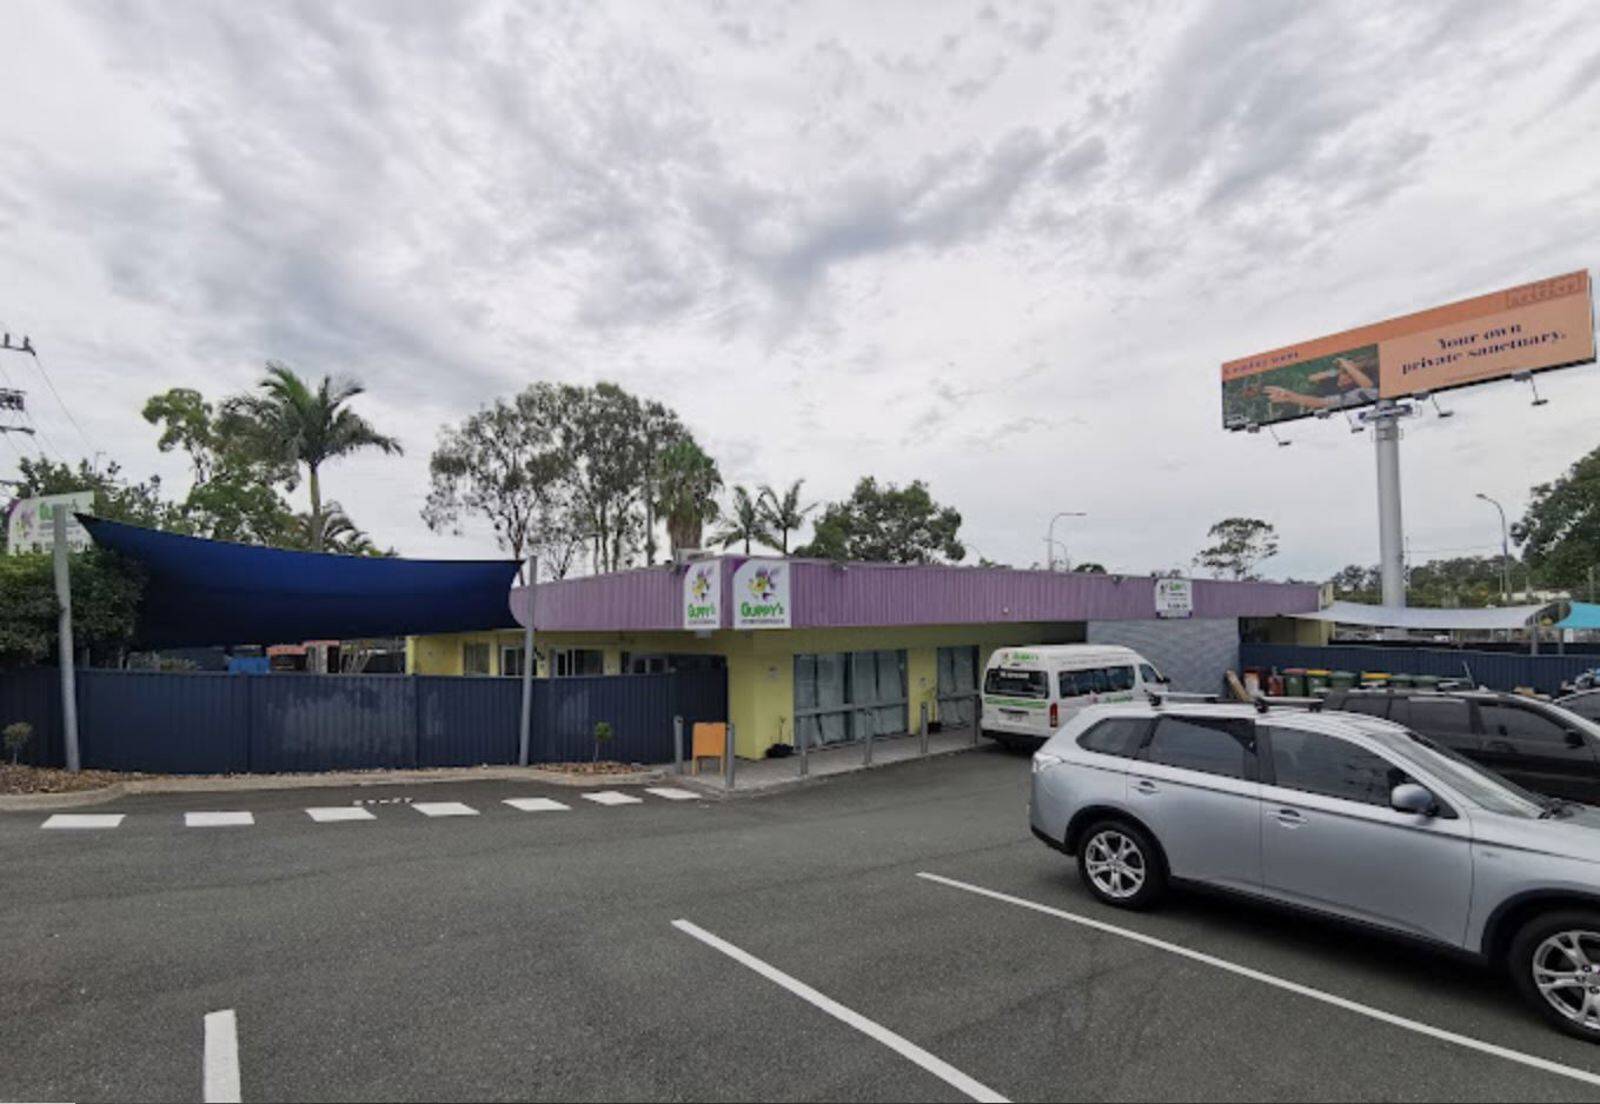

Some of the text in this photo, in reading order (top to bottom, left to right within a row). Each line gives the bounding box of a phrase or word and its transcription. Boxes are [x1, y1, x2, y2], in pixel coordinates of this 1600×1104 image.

[1437, 324, 1522, 349] Your own
[1402, 352, 1463, 374] private
